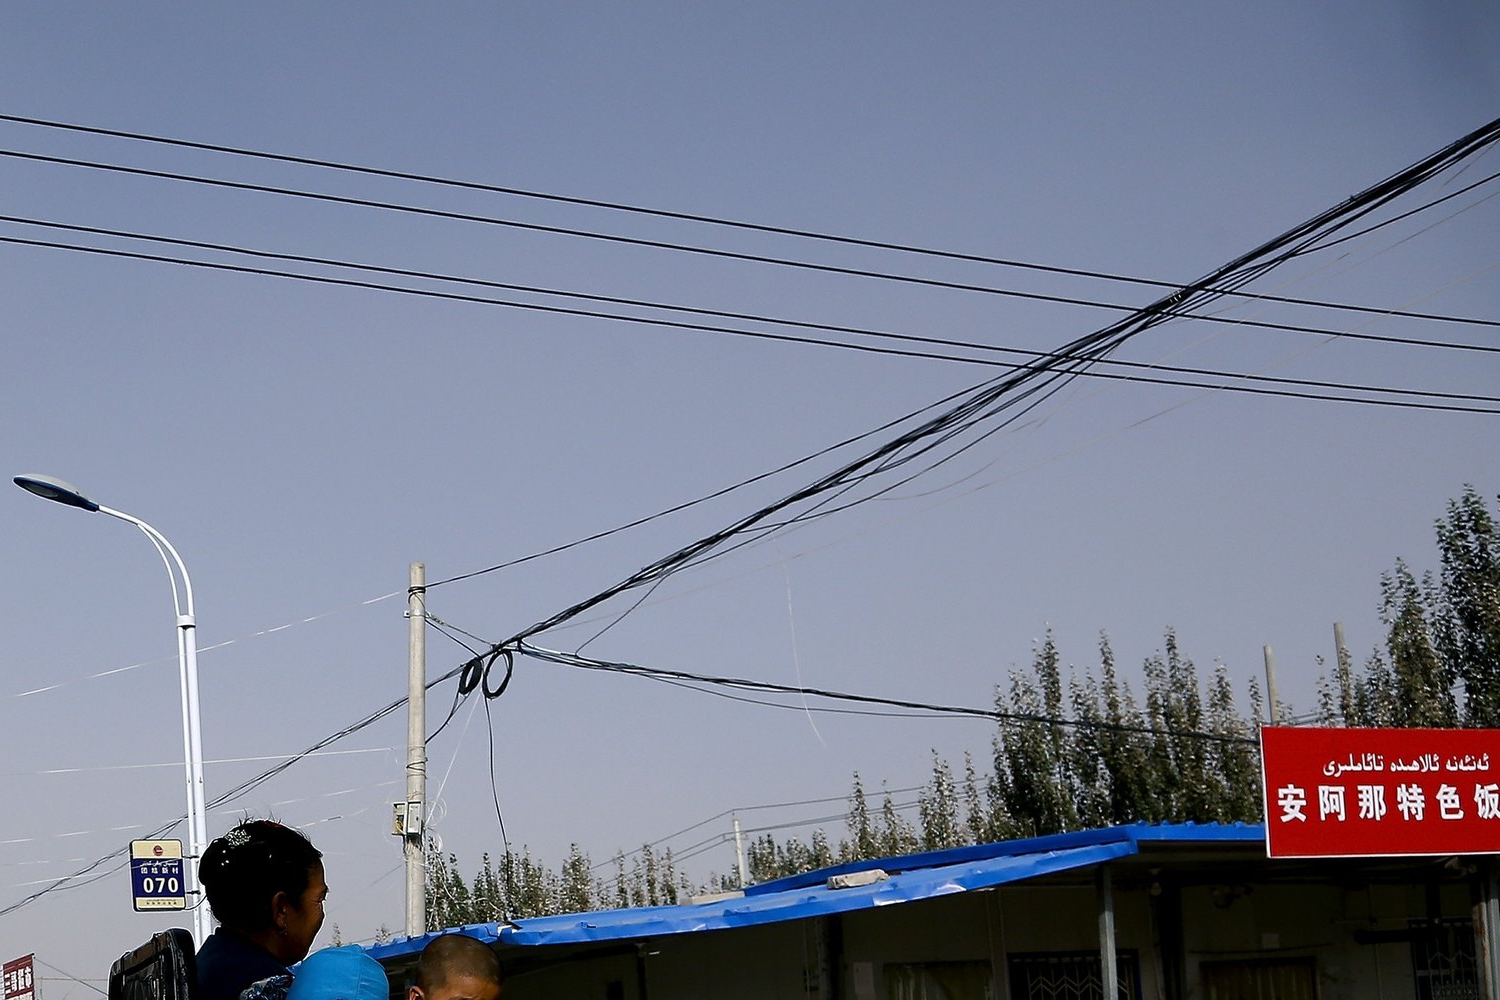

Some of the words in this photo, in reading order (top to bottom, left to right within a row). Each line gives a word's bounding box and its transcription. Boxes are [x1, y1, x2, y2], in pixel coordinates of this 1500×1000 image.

[1277, 783, 1500, 823] 安阿那特色饭
[143, 877, 179, 893] 070
